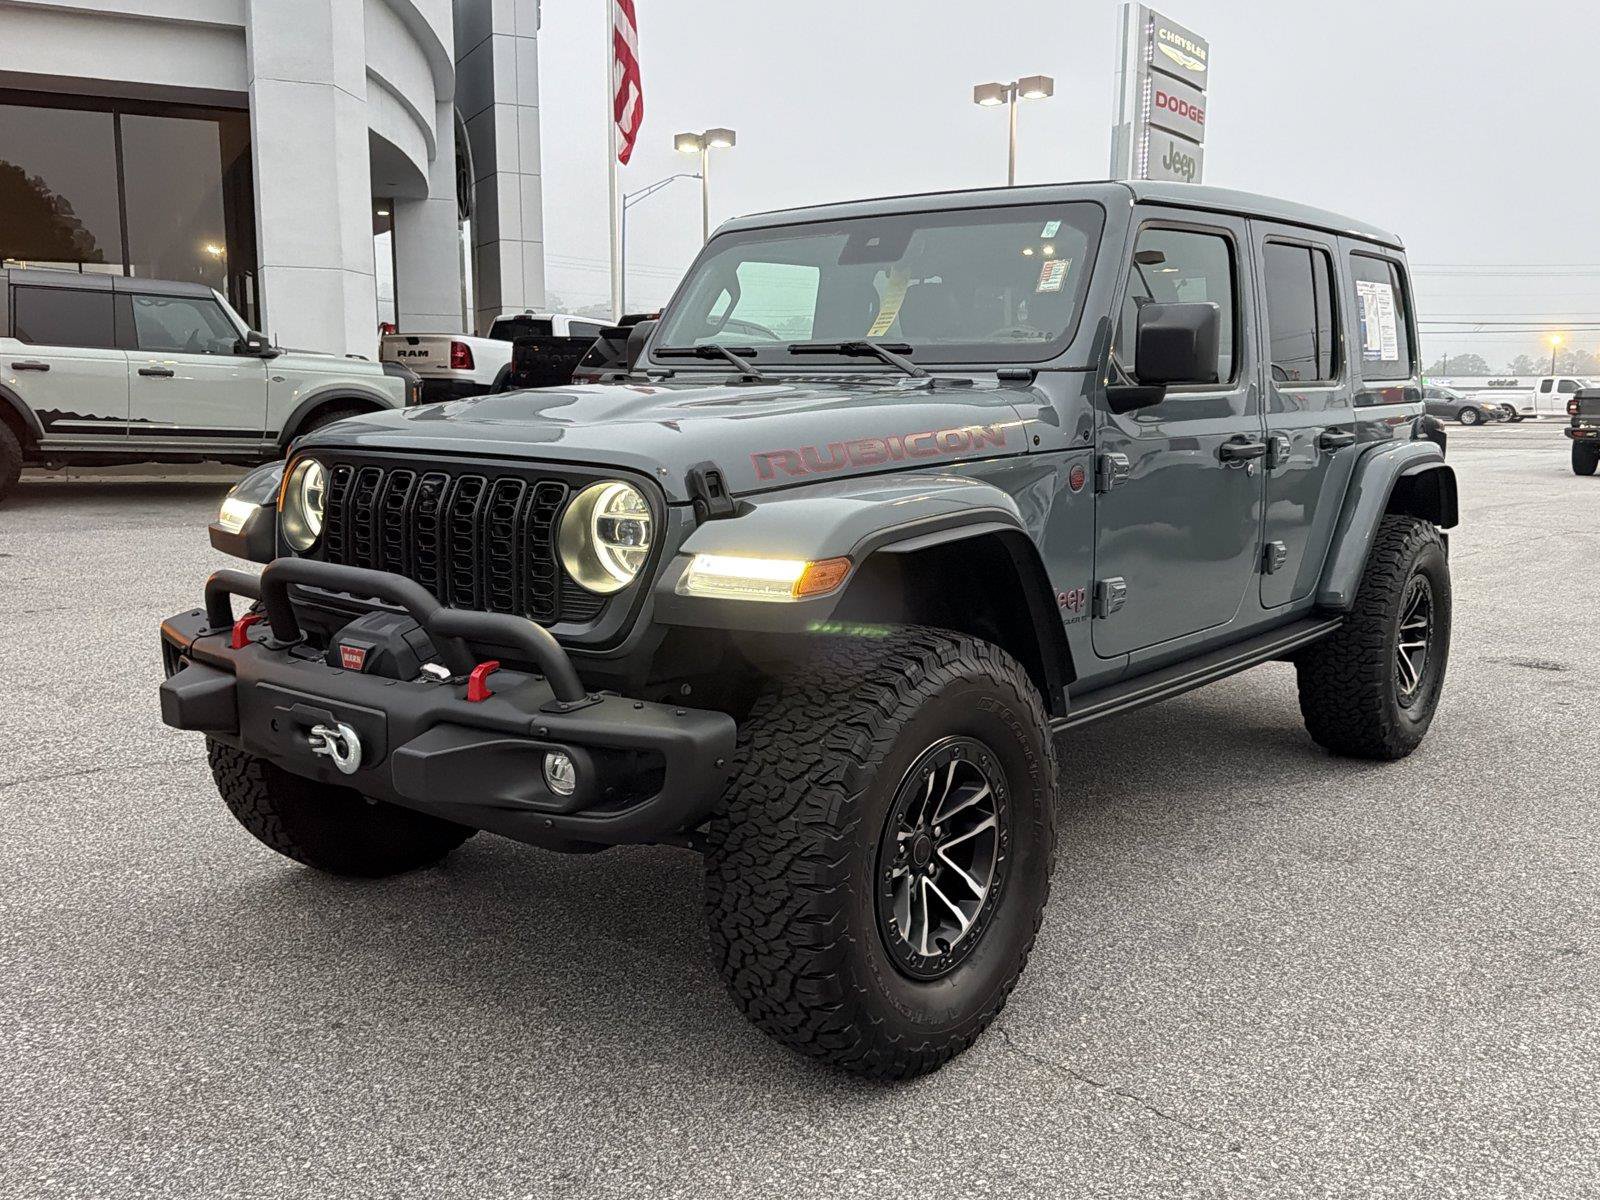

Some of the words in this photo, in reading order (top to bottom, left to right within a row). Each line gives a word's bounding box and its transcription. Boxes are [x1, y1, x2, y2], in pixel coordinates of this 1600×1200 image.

[1158, 28, 1206, 61] CHRYSLER
[1155, 90, 1205, 125] DODGE
[1162, 140, 1196, 183] Jeep
[397, 350, 429, 358] RAM
[750, 426, 1007, 481] RUBICON
[1053, 586, 1086, 614] eep
